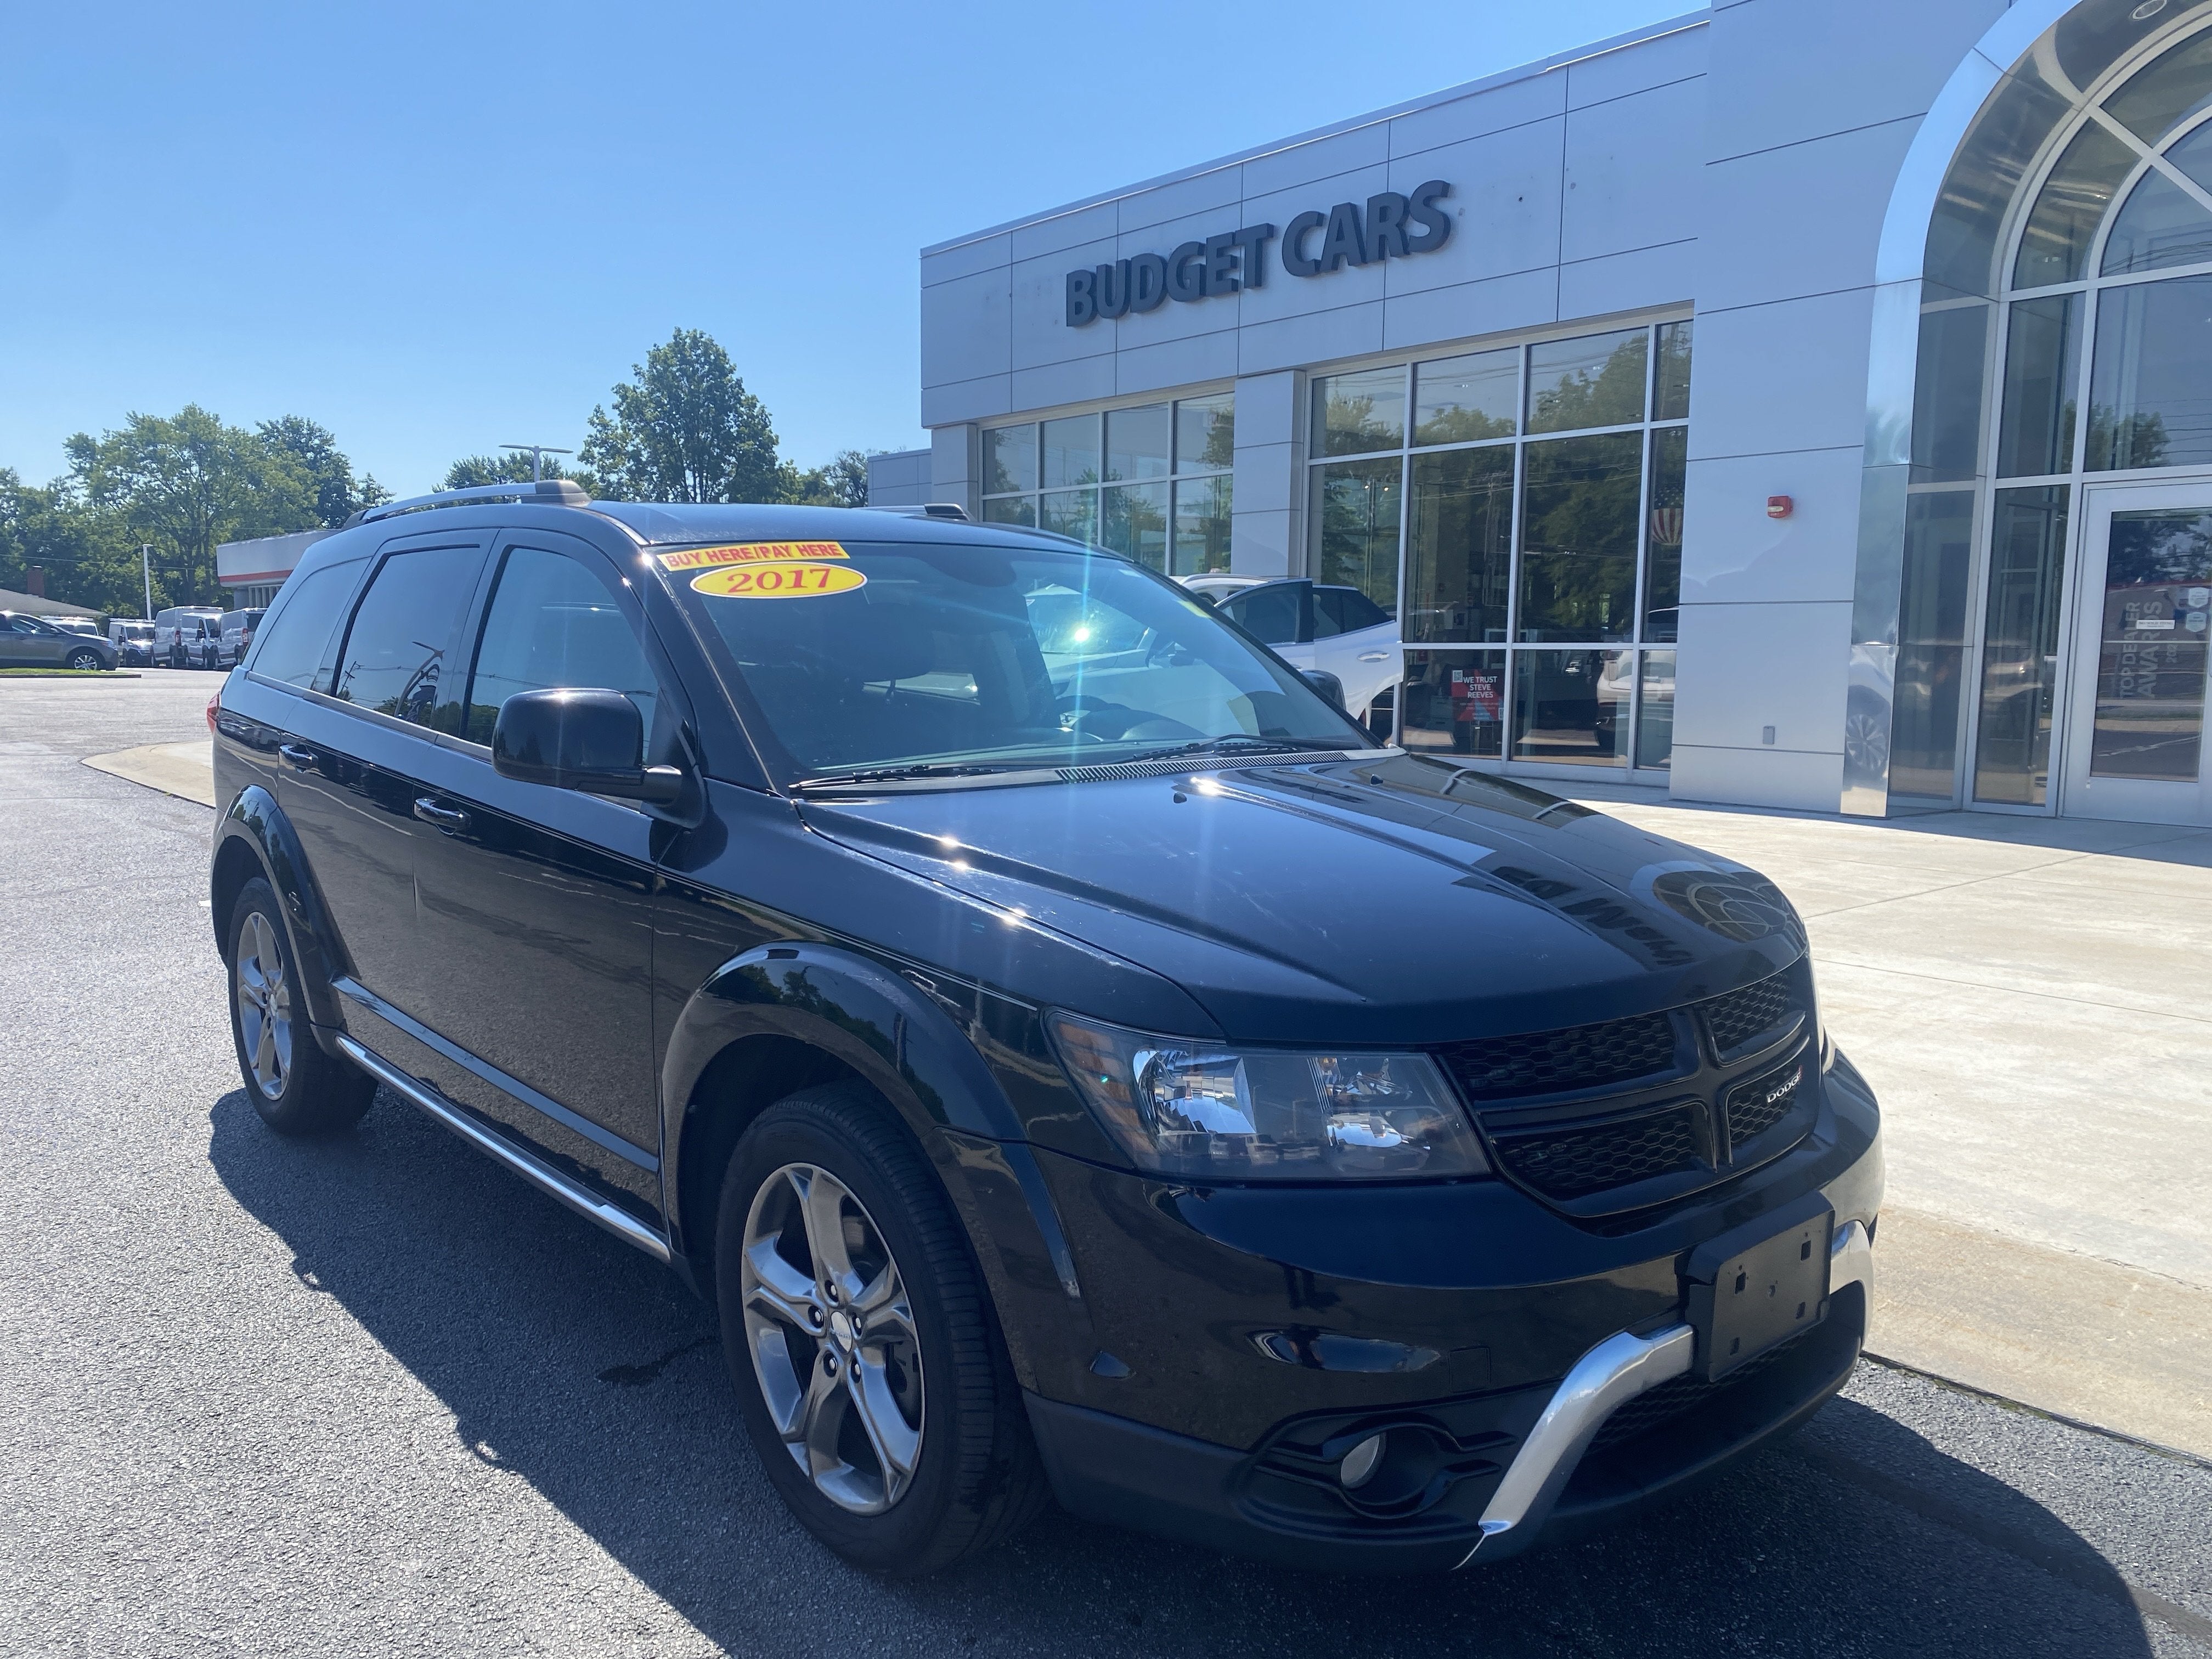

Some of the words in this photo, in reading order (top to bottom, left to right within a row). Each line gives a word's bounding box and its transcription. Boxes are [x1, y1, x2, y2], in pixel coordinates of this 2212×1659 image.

[1066, 222, 1274, 327] BUDGET
[1282, 180, 1452, 277] CARS
[665, 551, 702, 567] BUY
[795, 544, 844, 557] HERE
[727, 568, 831, 592] 2017
